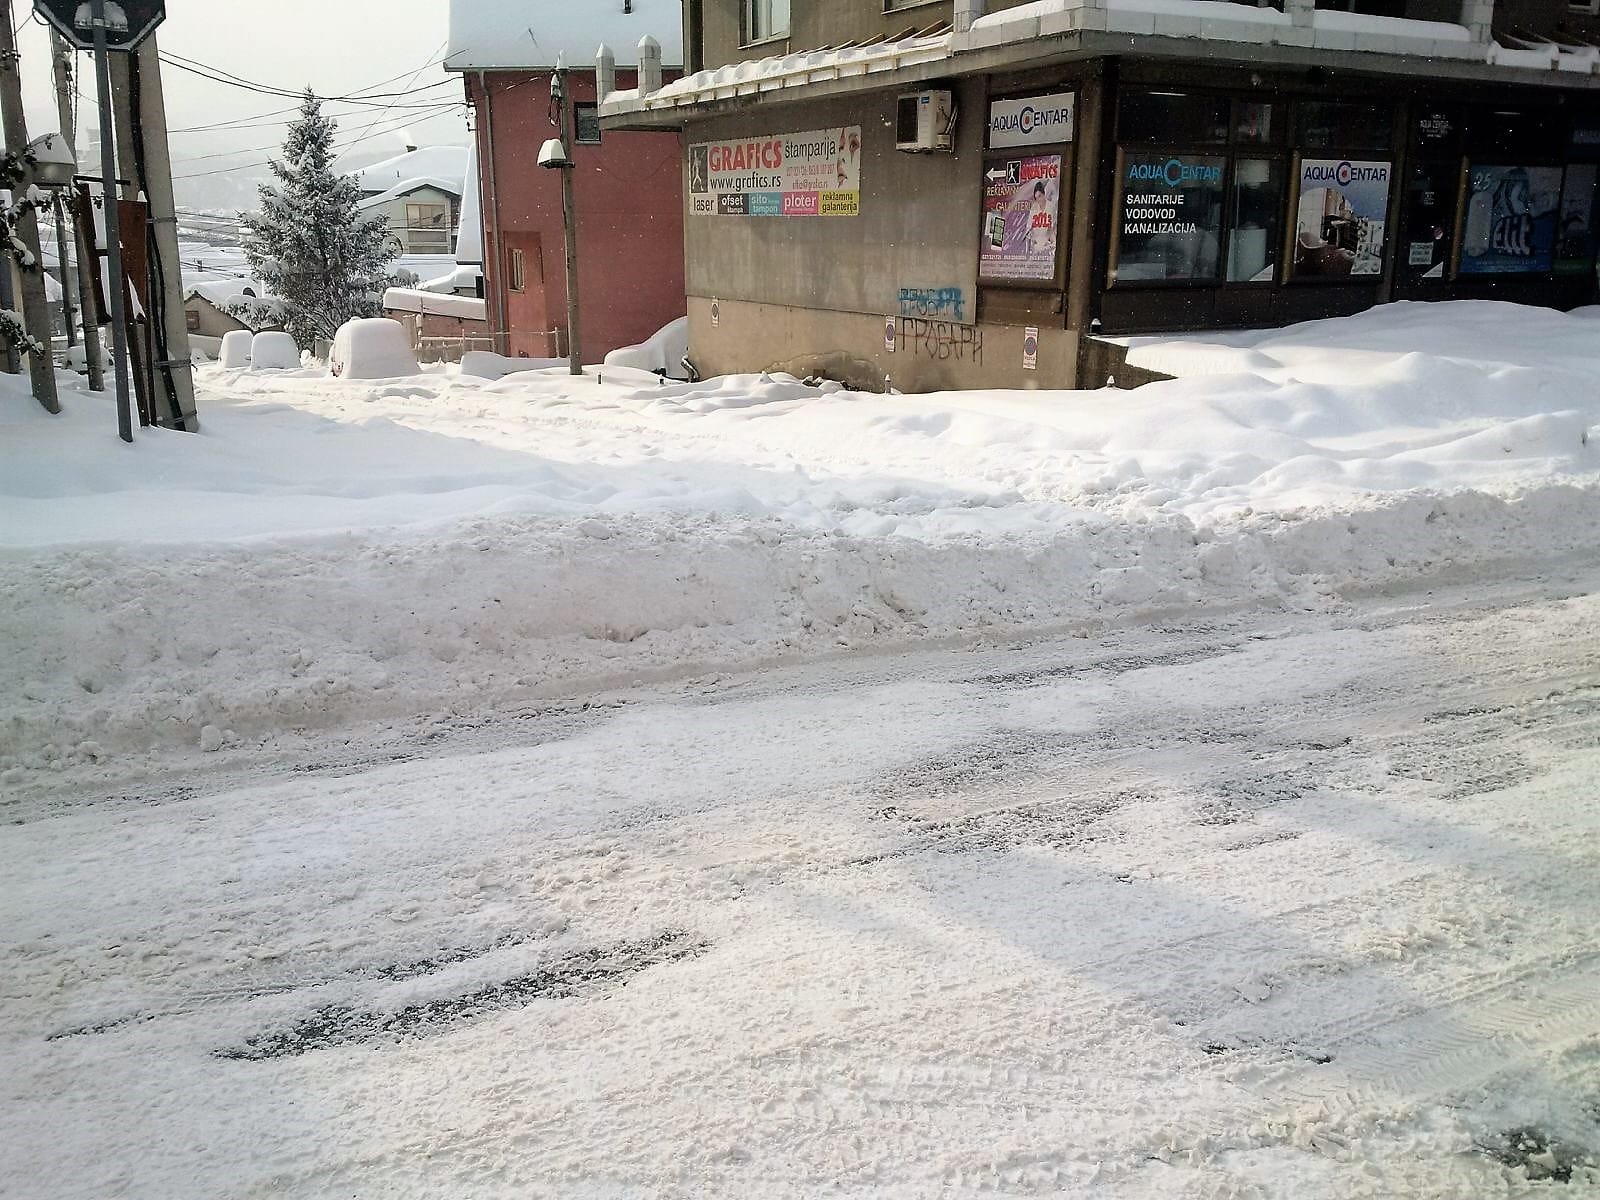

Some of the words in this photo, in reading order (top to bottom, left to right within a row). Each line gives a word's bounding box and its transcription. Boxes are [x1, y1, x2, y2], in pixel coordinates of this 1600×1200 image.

[709, 140, 782, 172] GRAFICS
[784, 136, 836, 161] štamparija
[710, 171, 781, 192] www.grafics.rs
[693, 196, 714, 211] laser
[721, 194, 743, 206] ofset
[784, 193, 817, 211] ploter
[1126, 194, 1185, 205] SANITARIJE
[1125, 208, 1176, 219] VODOVOD
[1124, 222, 1197, 234] KANALIZACIJA
